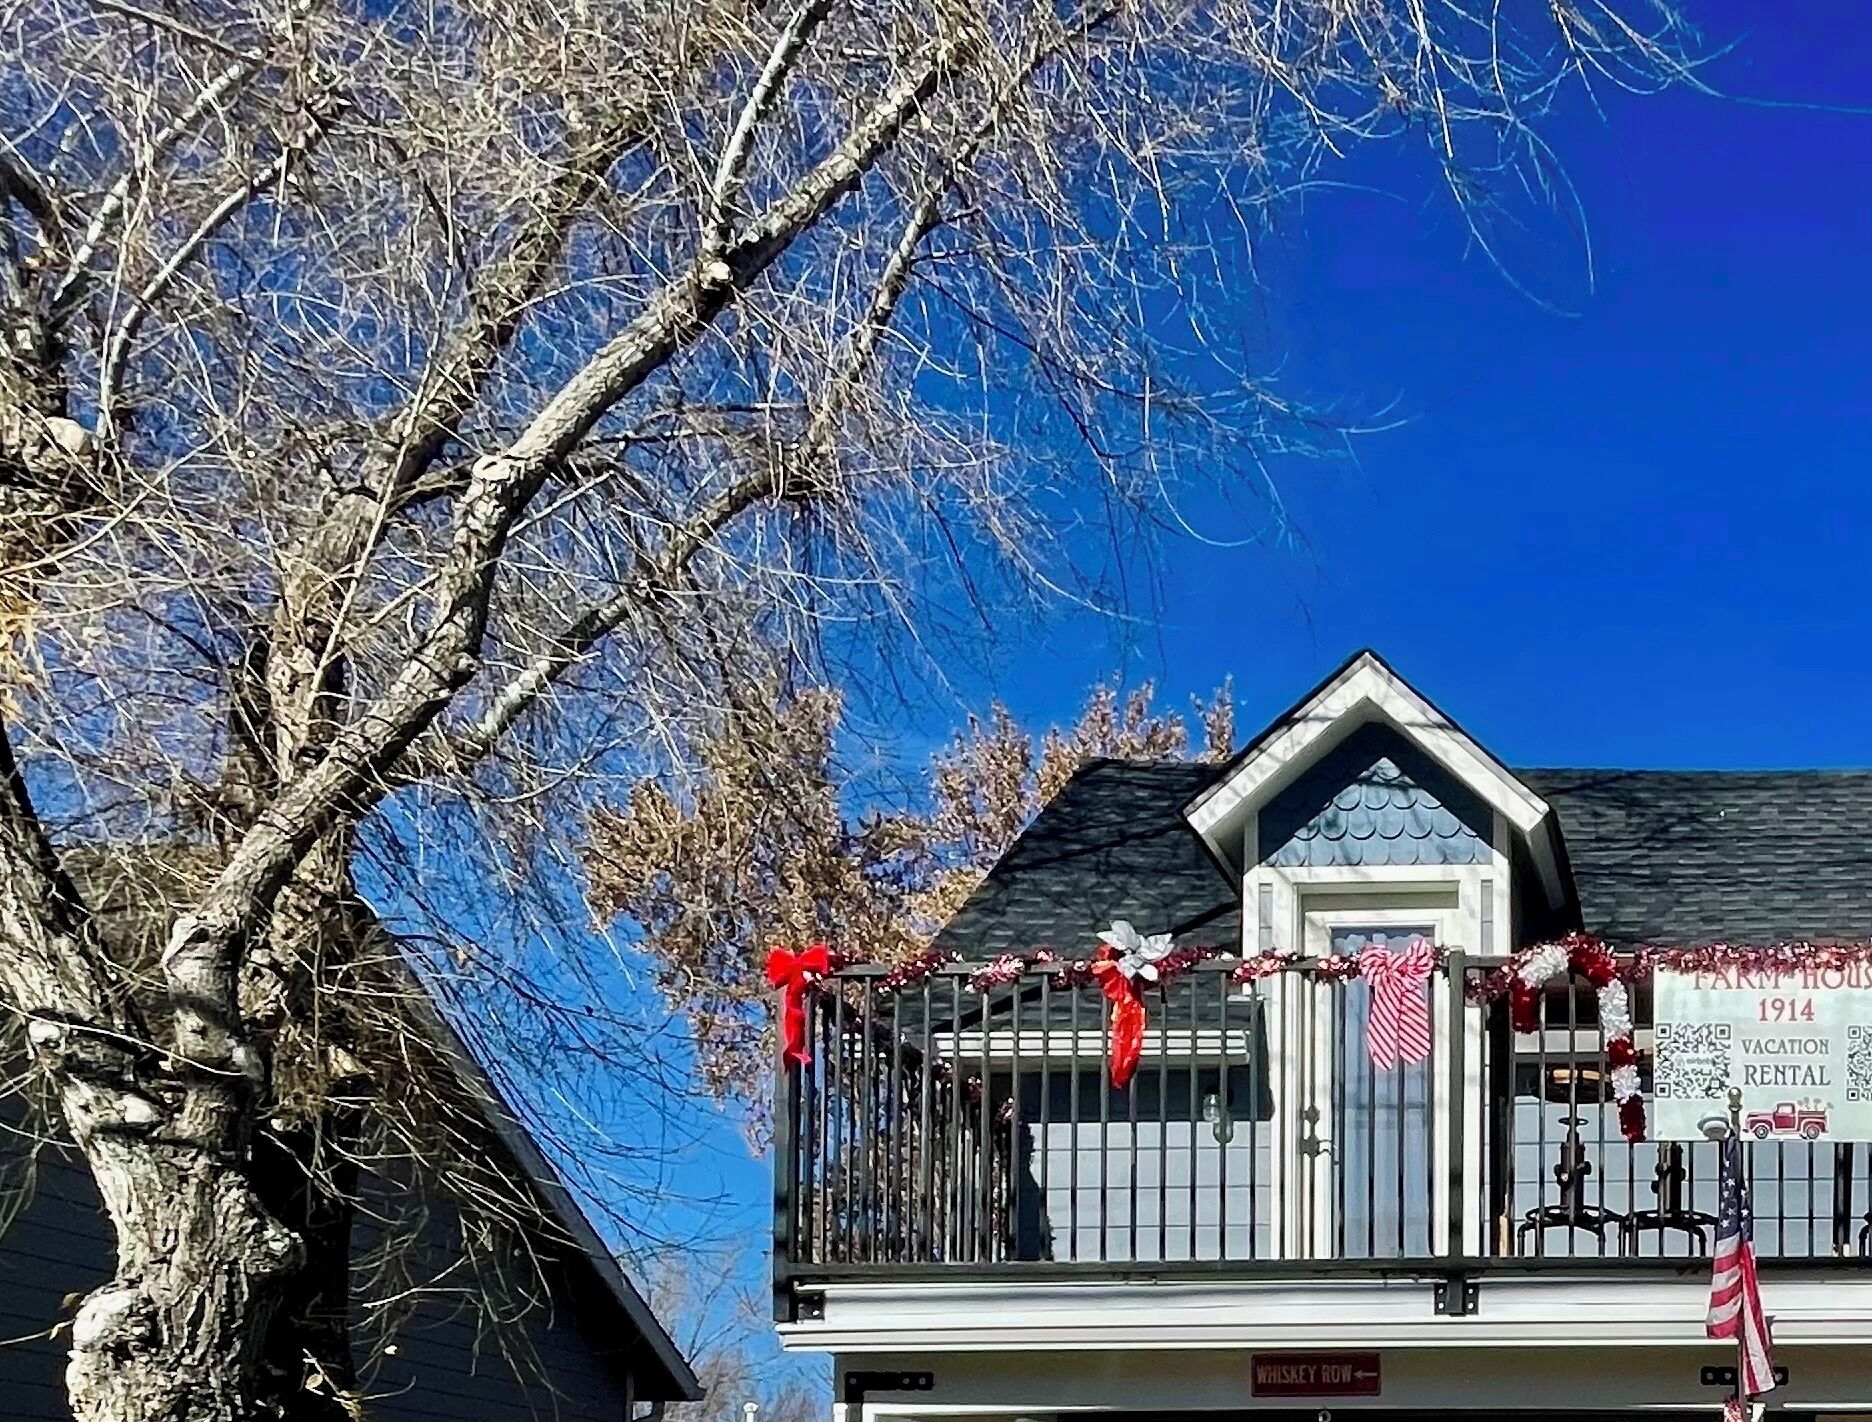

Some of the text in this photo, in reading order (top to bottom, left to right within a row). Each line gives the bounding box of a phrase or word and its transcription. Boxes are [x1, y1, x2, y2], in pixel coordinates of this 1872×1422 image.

[1693, 966, 1781, 990] FARM
[1759, 998, 1815, 1022] 1914
[1741, 1038, 1830, 1055] VACATION
[1743, 1064, 1832, 1087] RENTAL
[1256, 1364, 1353, 1385] WHISKEY ROW
